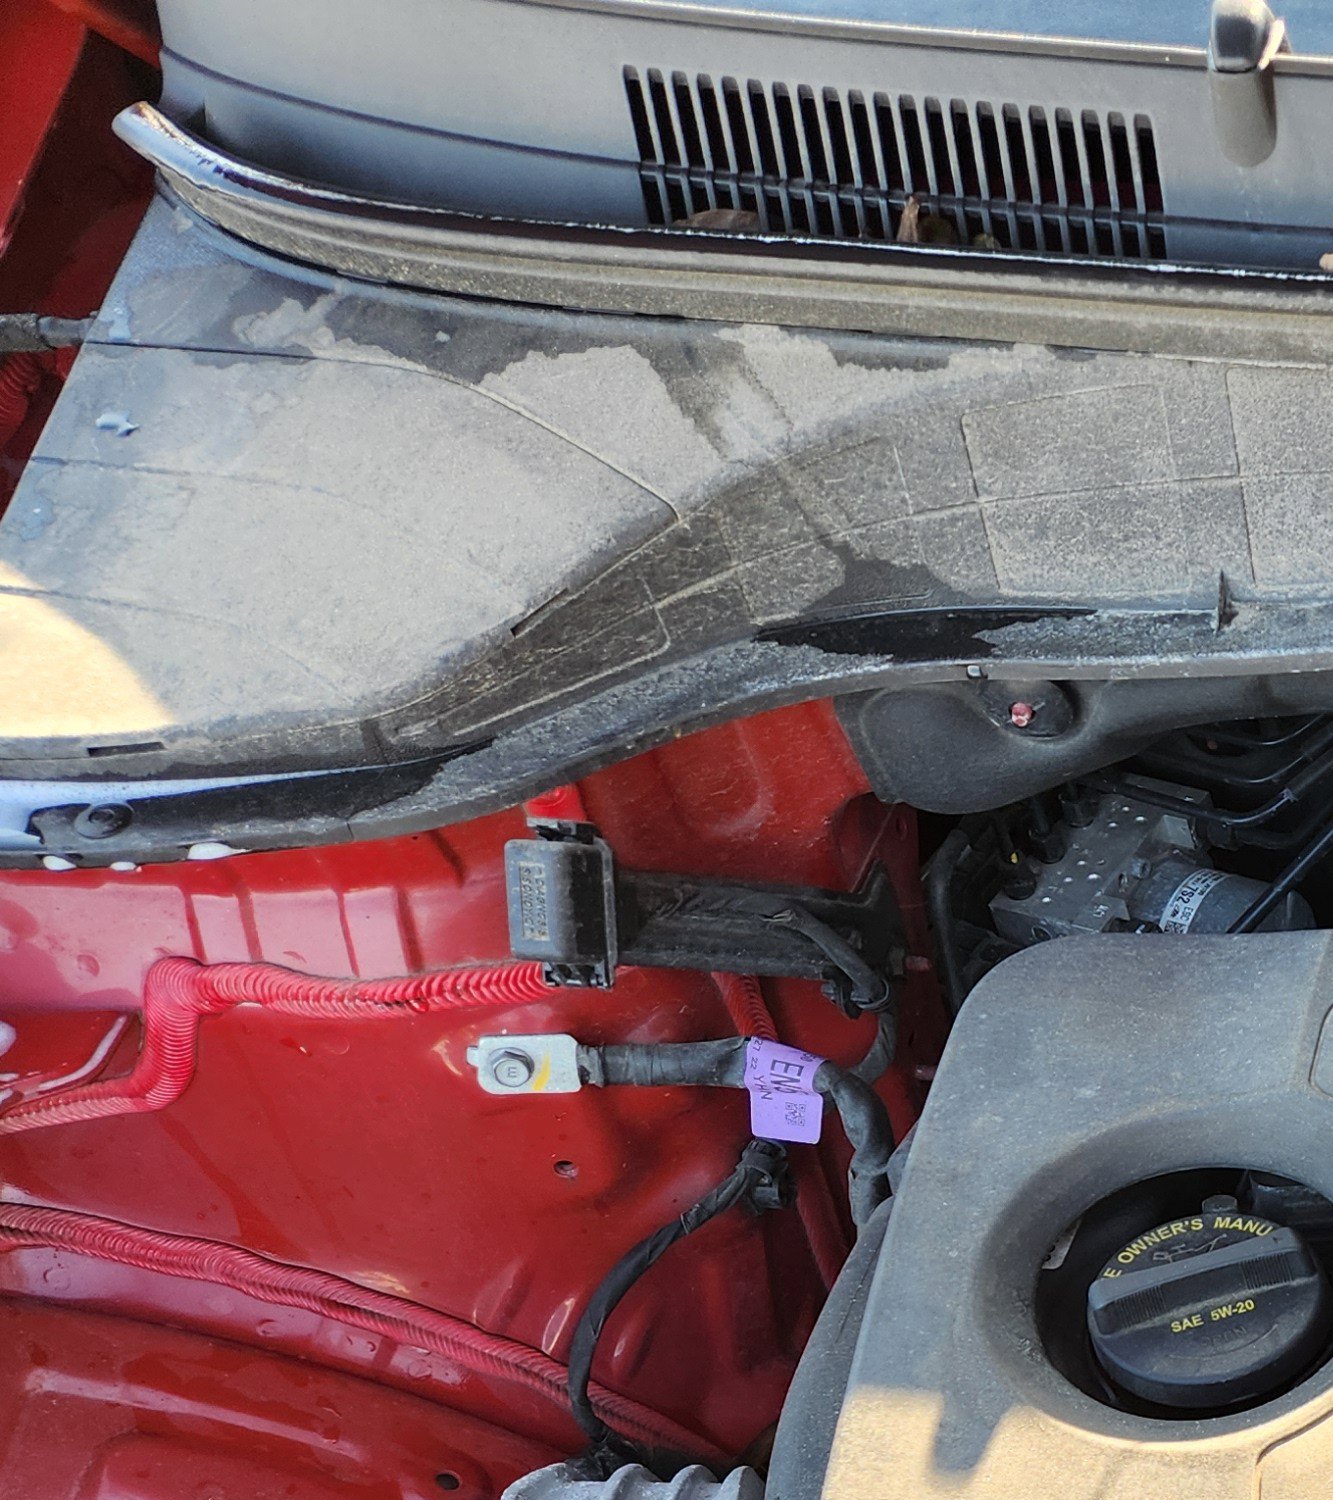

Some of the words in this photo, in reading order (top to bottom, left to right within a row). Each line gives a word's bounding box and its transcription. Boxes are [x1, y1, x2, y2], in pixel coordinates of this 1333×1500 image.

[1117, 1218, 1204, 1266] OWNER'S
[1213, 1216, 1275, 1238] MANU
[1170, 1314, 1204, 1334] SAE
[1210, 1299, 1255, 1321] 5W-20
